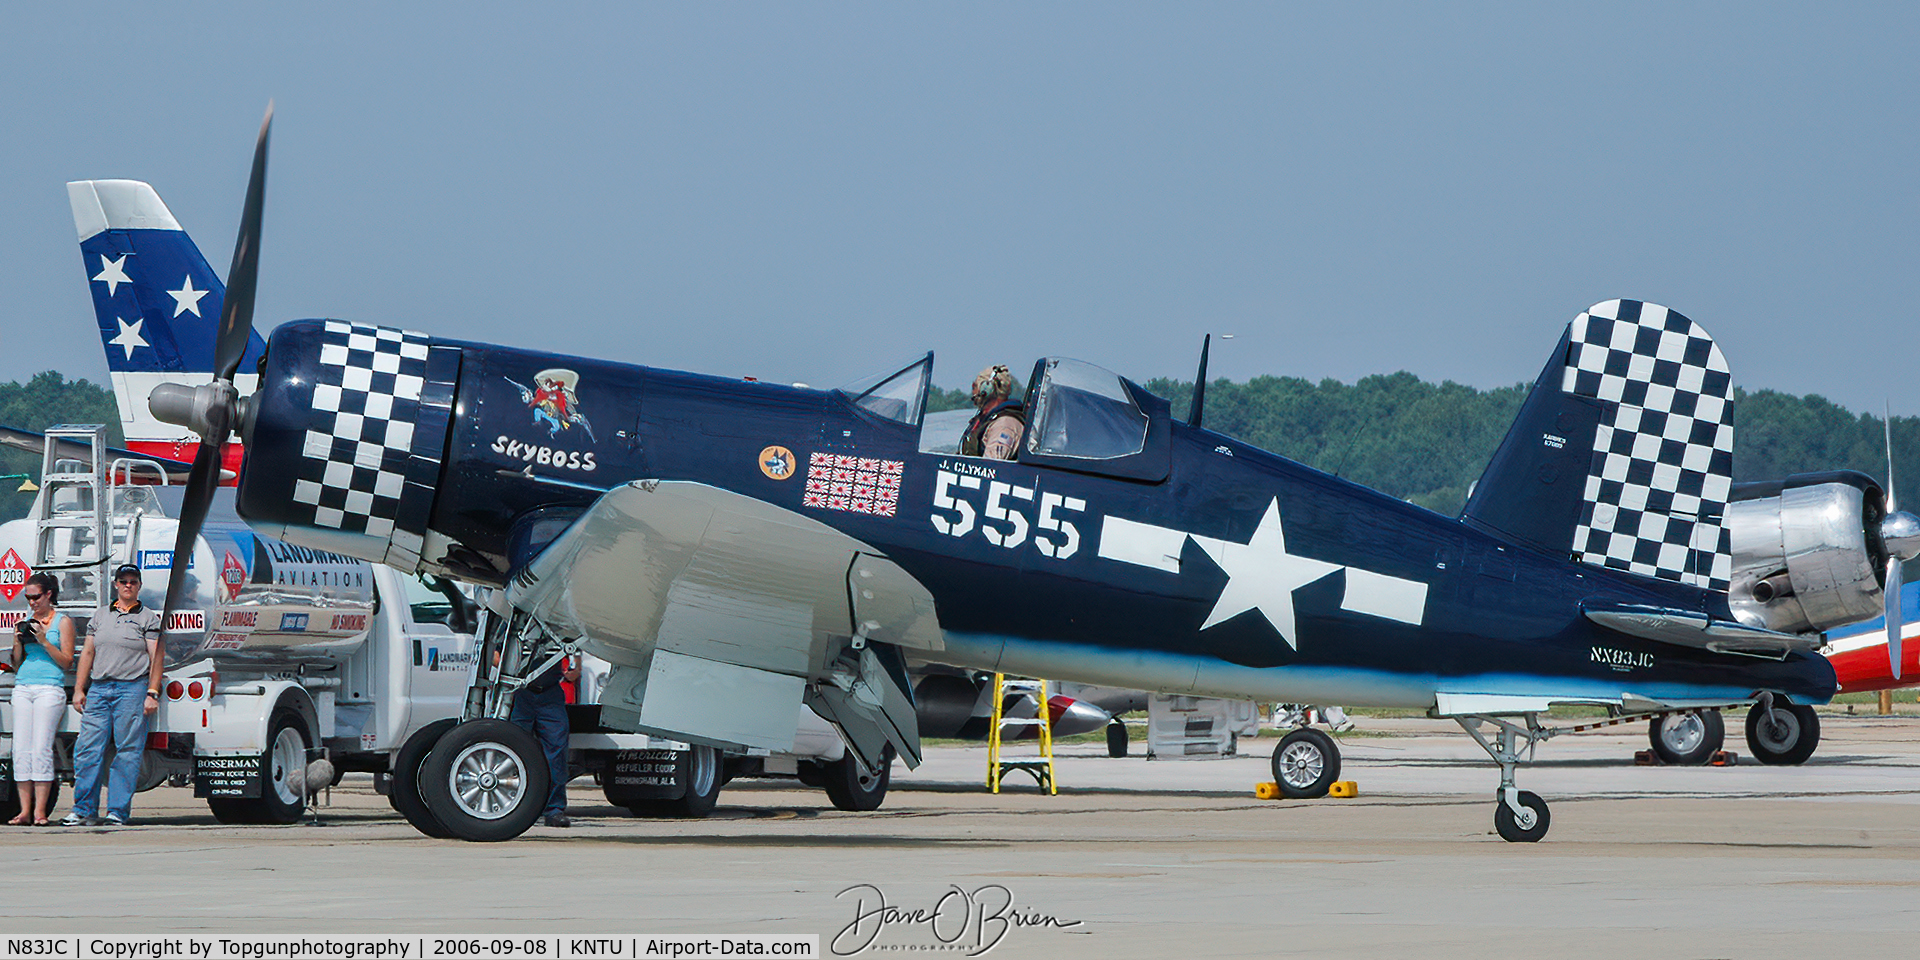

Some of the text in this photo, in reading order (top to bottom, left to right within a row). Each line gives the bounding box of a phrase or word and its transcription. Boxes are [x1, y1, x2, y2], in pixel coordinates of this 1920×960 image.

[490, 435, 597, 471] SKYBOSS
[938, 459, 997, 479] J. CLYMAN
[930, 470, 1087, 560] 555
[279, 570, 363, 587] AVIATION
[1591, 646, 1654, 668] NX83JC
[198, 759, 259, 769] BOSSERMAN
